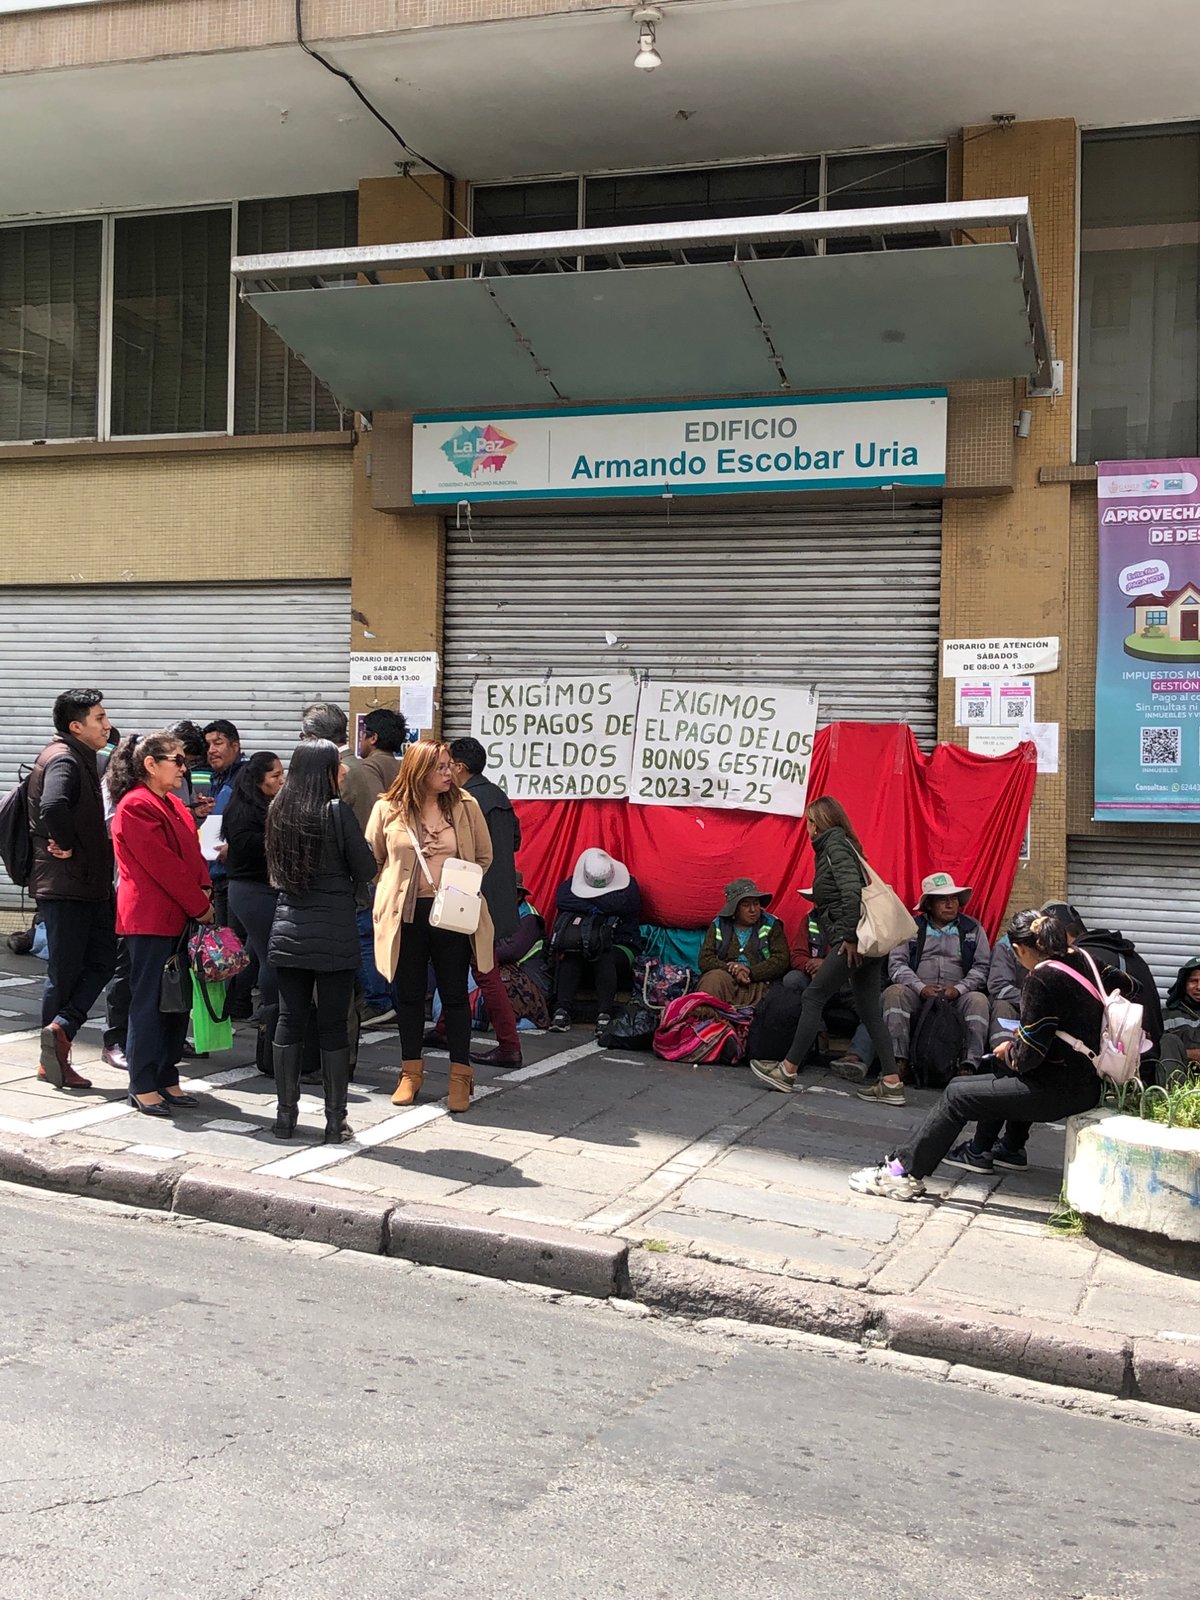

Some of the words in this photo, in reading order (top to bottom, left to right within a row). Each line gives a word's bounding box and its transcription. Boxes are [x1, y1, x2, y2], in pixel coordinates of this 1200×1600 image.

[685, 417, 797, 443] EDIFICIO
[453, 438, 473, 454] La
[476, 437, 504, 453] Paz
[571, 450, 706, 480] Armando
[717, 445, 844, 474] Escobar
[855, 441, 918, 468] Uria
[1151, 530, 1173, 543] DE
[1176, 528, 1200, 542] DE
[1003, 641, 1049, 649] ATENCIÓN
[1012, 662, 1034, 670] 13:00
[1122, 671, 1184, 680] IMPUESTOS
[1152, 680, 1199, 690] GESTIÓN
[488, 683, 612, 708] EXIGIMOS
[659, 688, 776, 721] EXIGIMOS
[1151, 693, 1177, 703] Pago
[1179, 693, 1188, 701] al
[1135, 703, 1151, 711] Sin
[1153, 703, 1186, 711] multas
[1189, 703, 1198, 711] ni
[480, 713, 517, 736] LOS
[524, 712, 593, 736] PAGOS
[605, 714, 634, 736] DE
[645, 718, 670, 741] EL
[675, 720, 732, 745] PAGO
[739, 726, 769, 750] DE
[772, 730, 813, 756] LOS
[487, 742, 617, 769] SUELDOS
[642, 748, 710, 771] BONOS
[719, 752, 806, 785] GESTION
[639, 776, 772, 804] 2023-24-25
[1135, 783, 1168, 791] Consultas:
